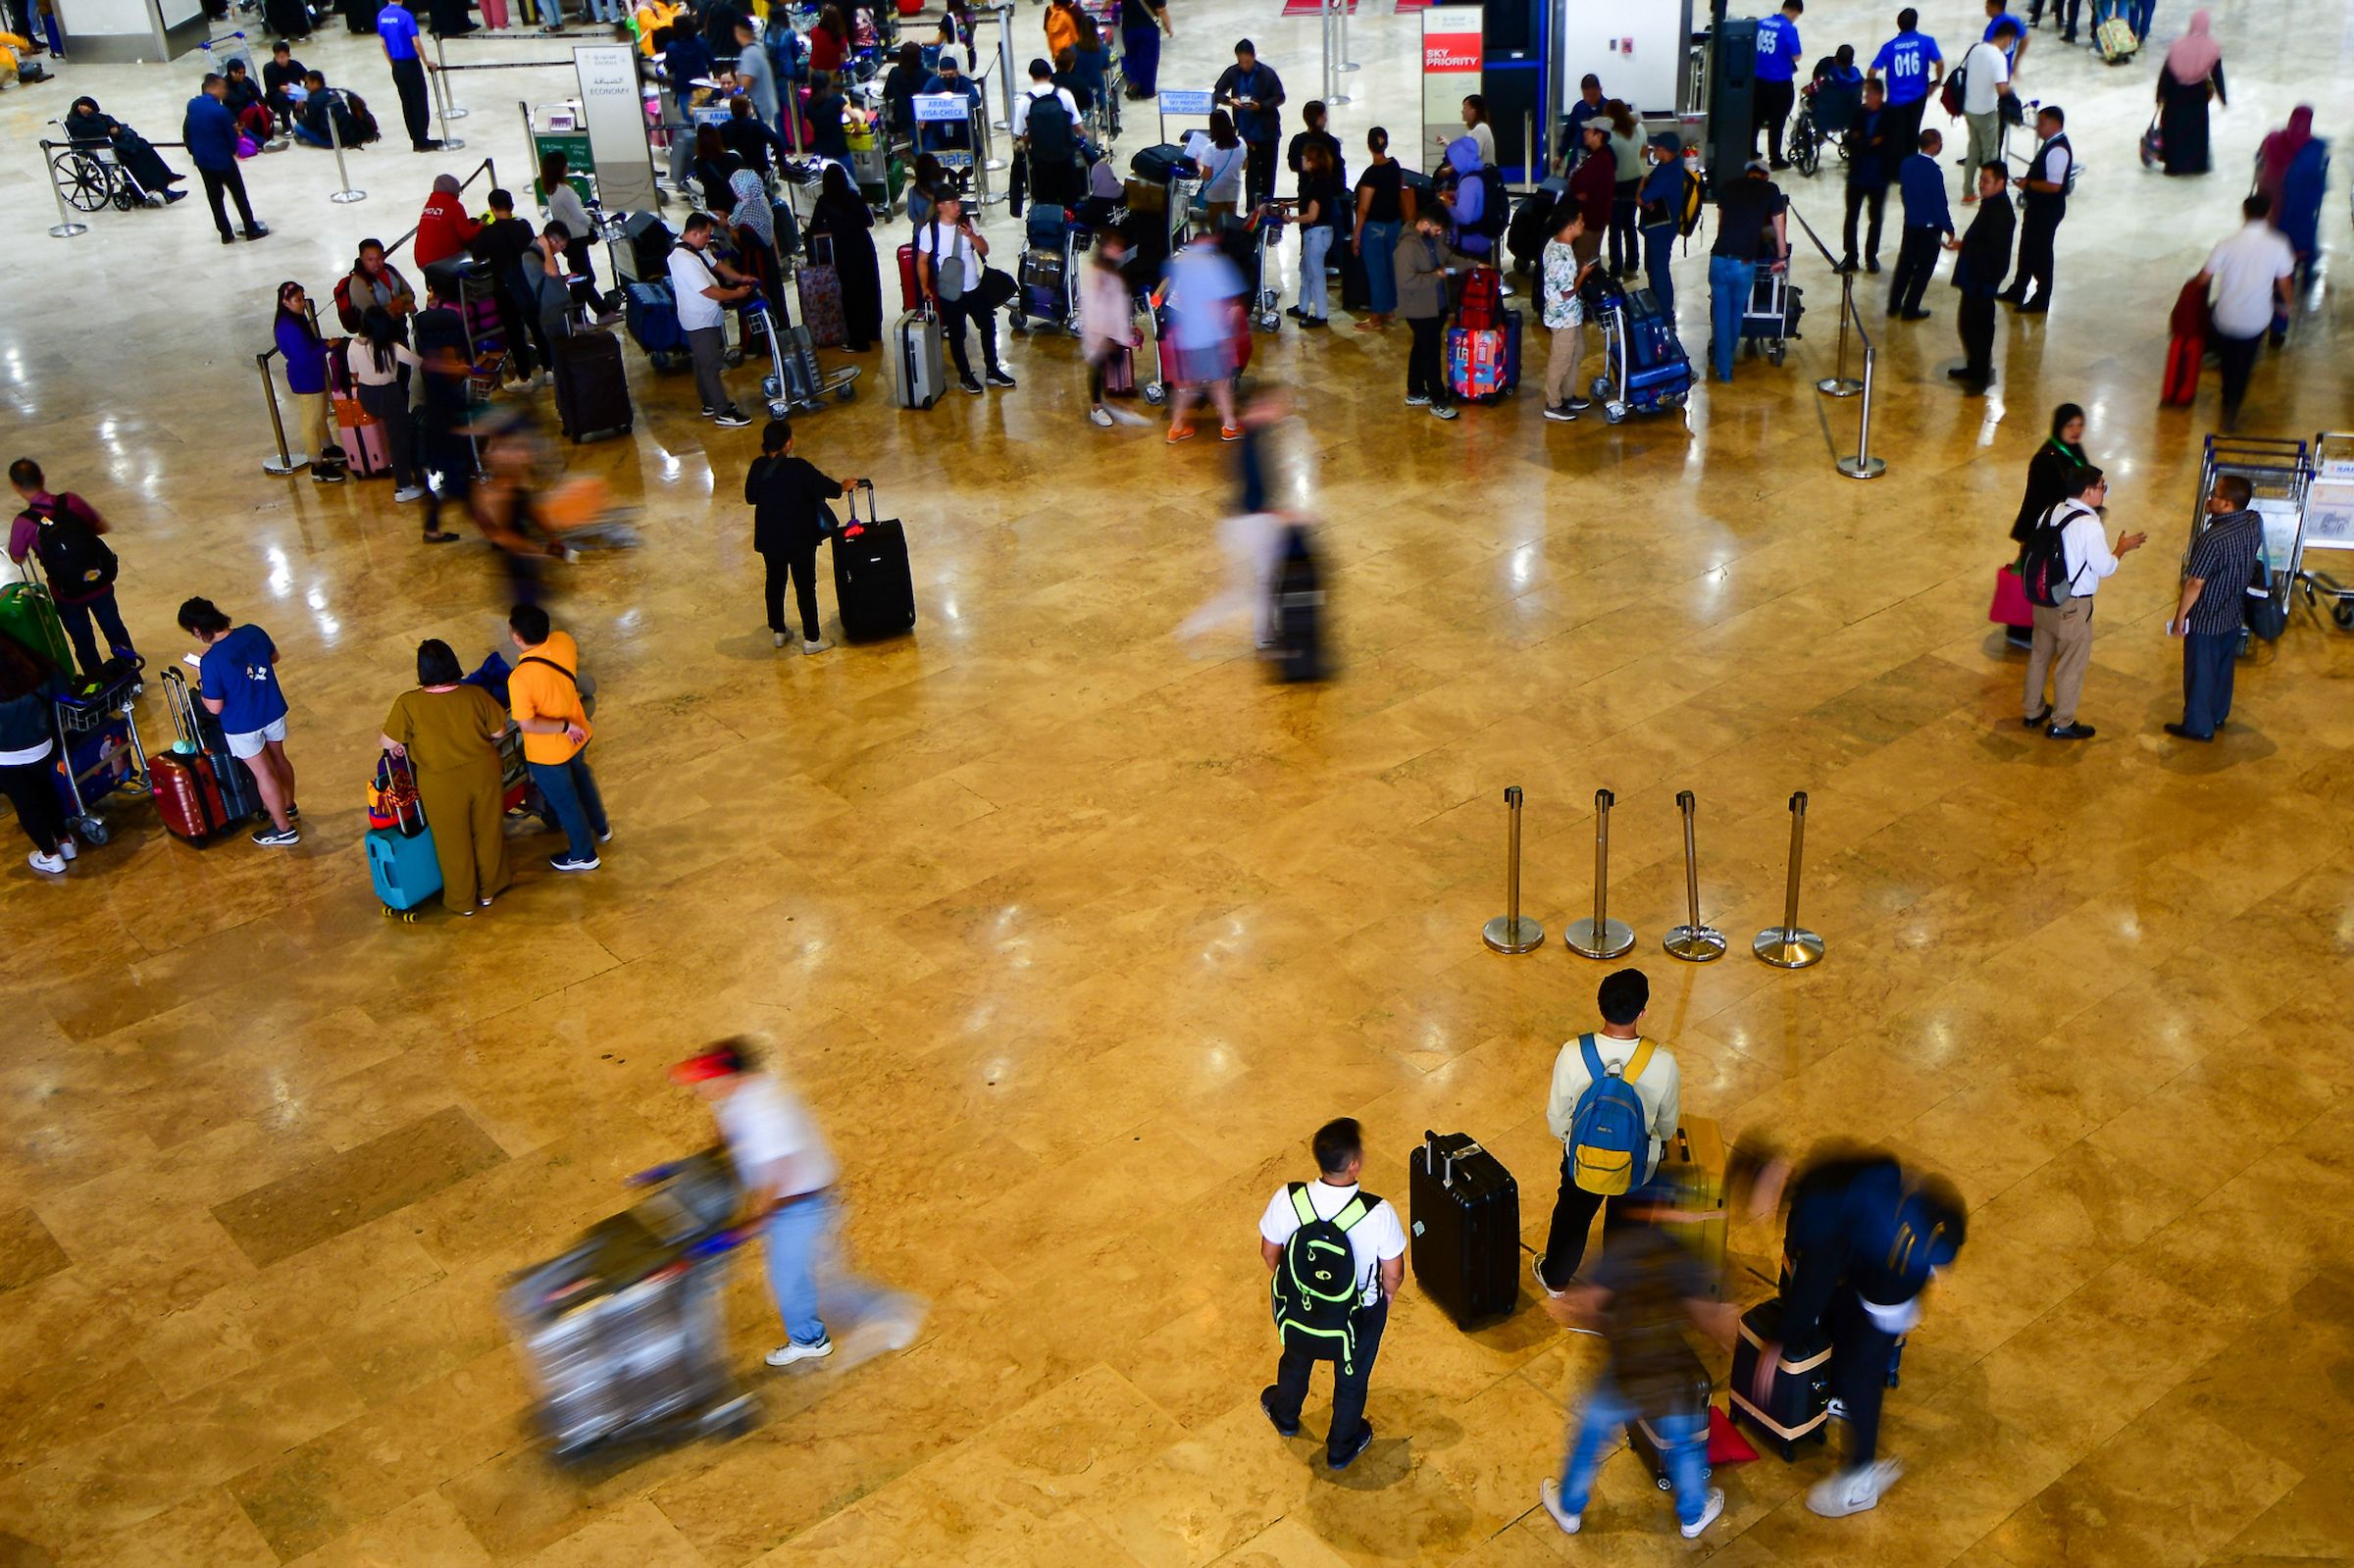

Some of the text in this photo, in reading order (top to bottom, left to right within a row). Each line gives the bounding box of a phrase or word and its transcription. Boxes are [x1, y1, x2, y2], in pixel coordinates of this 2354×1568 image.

[1757, 28, 1777, 55] 055
[1426, 48, 1450, 58] SKY
[1426, 57, 1479, 67] PRIORITY
[1894, 50, 1920, 77] 016
[589, 86, 630, 95] ECONOMY
[920, 109, 964, 118] VISA-CHECK
